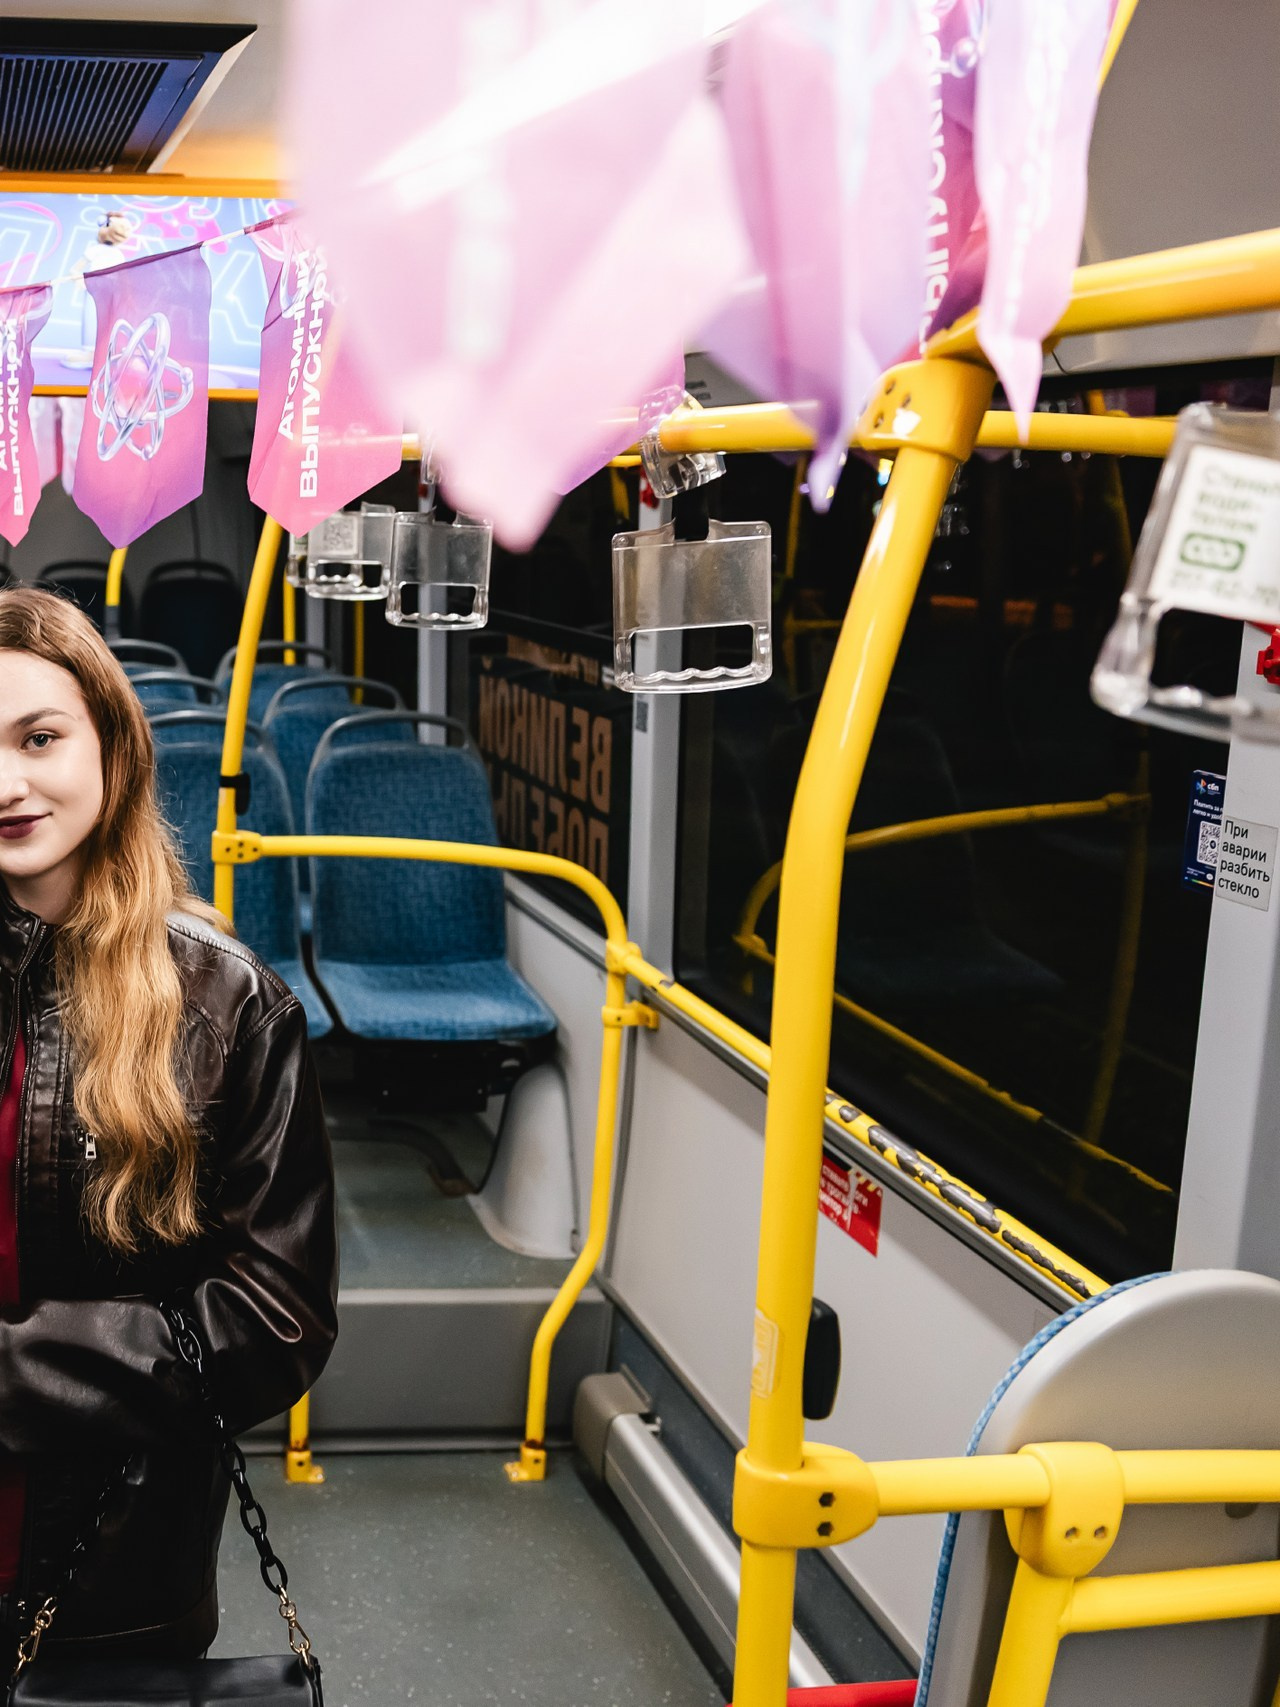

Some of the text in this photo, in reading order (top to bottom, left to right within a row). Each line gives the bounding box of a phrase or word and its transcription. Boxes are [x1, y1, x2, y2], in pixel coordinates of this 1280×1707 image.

[278, 249, 310, 440] АТОМНЫЙ
[300, 247, 328, 497] ВЫПУСКНОЙ
[5, 319, 24, 516] ВЫПУСКНОЙ
[1224, 819, 1249, 839] При
[1222, 841, 1267, 863] аварии
[1220, 860, 1271, 882] разбить
[1218, 877, 1260, 899] стекло
